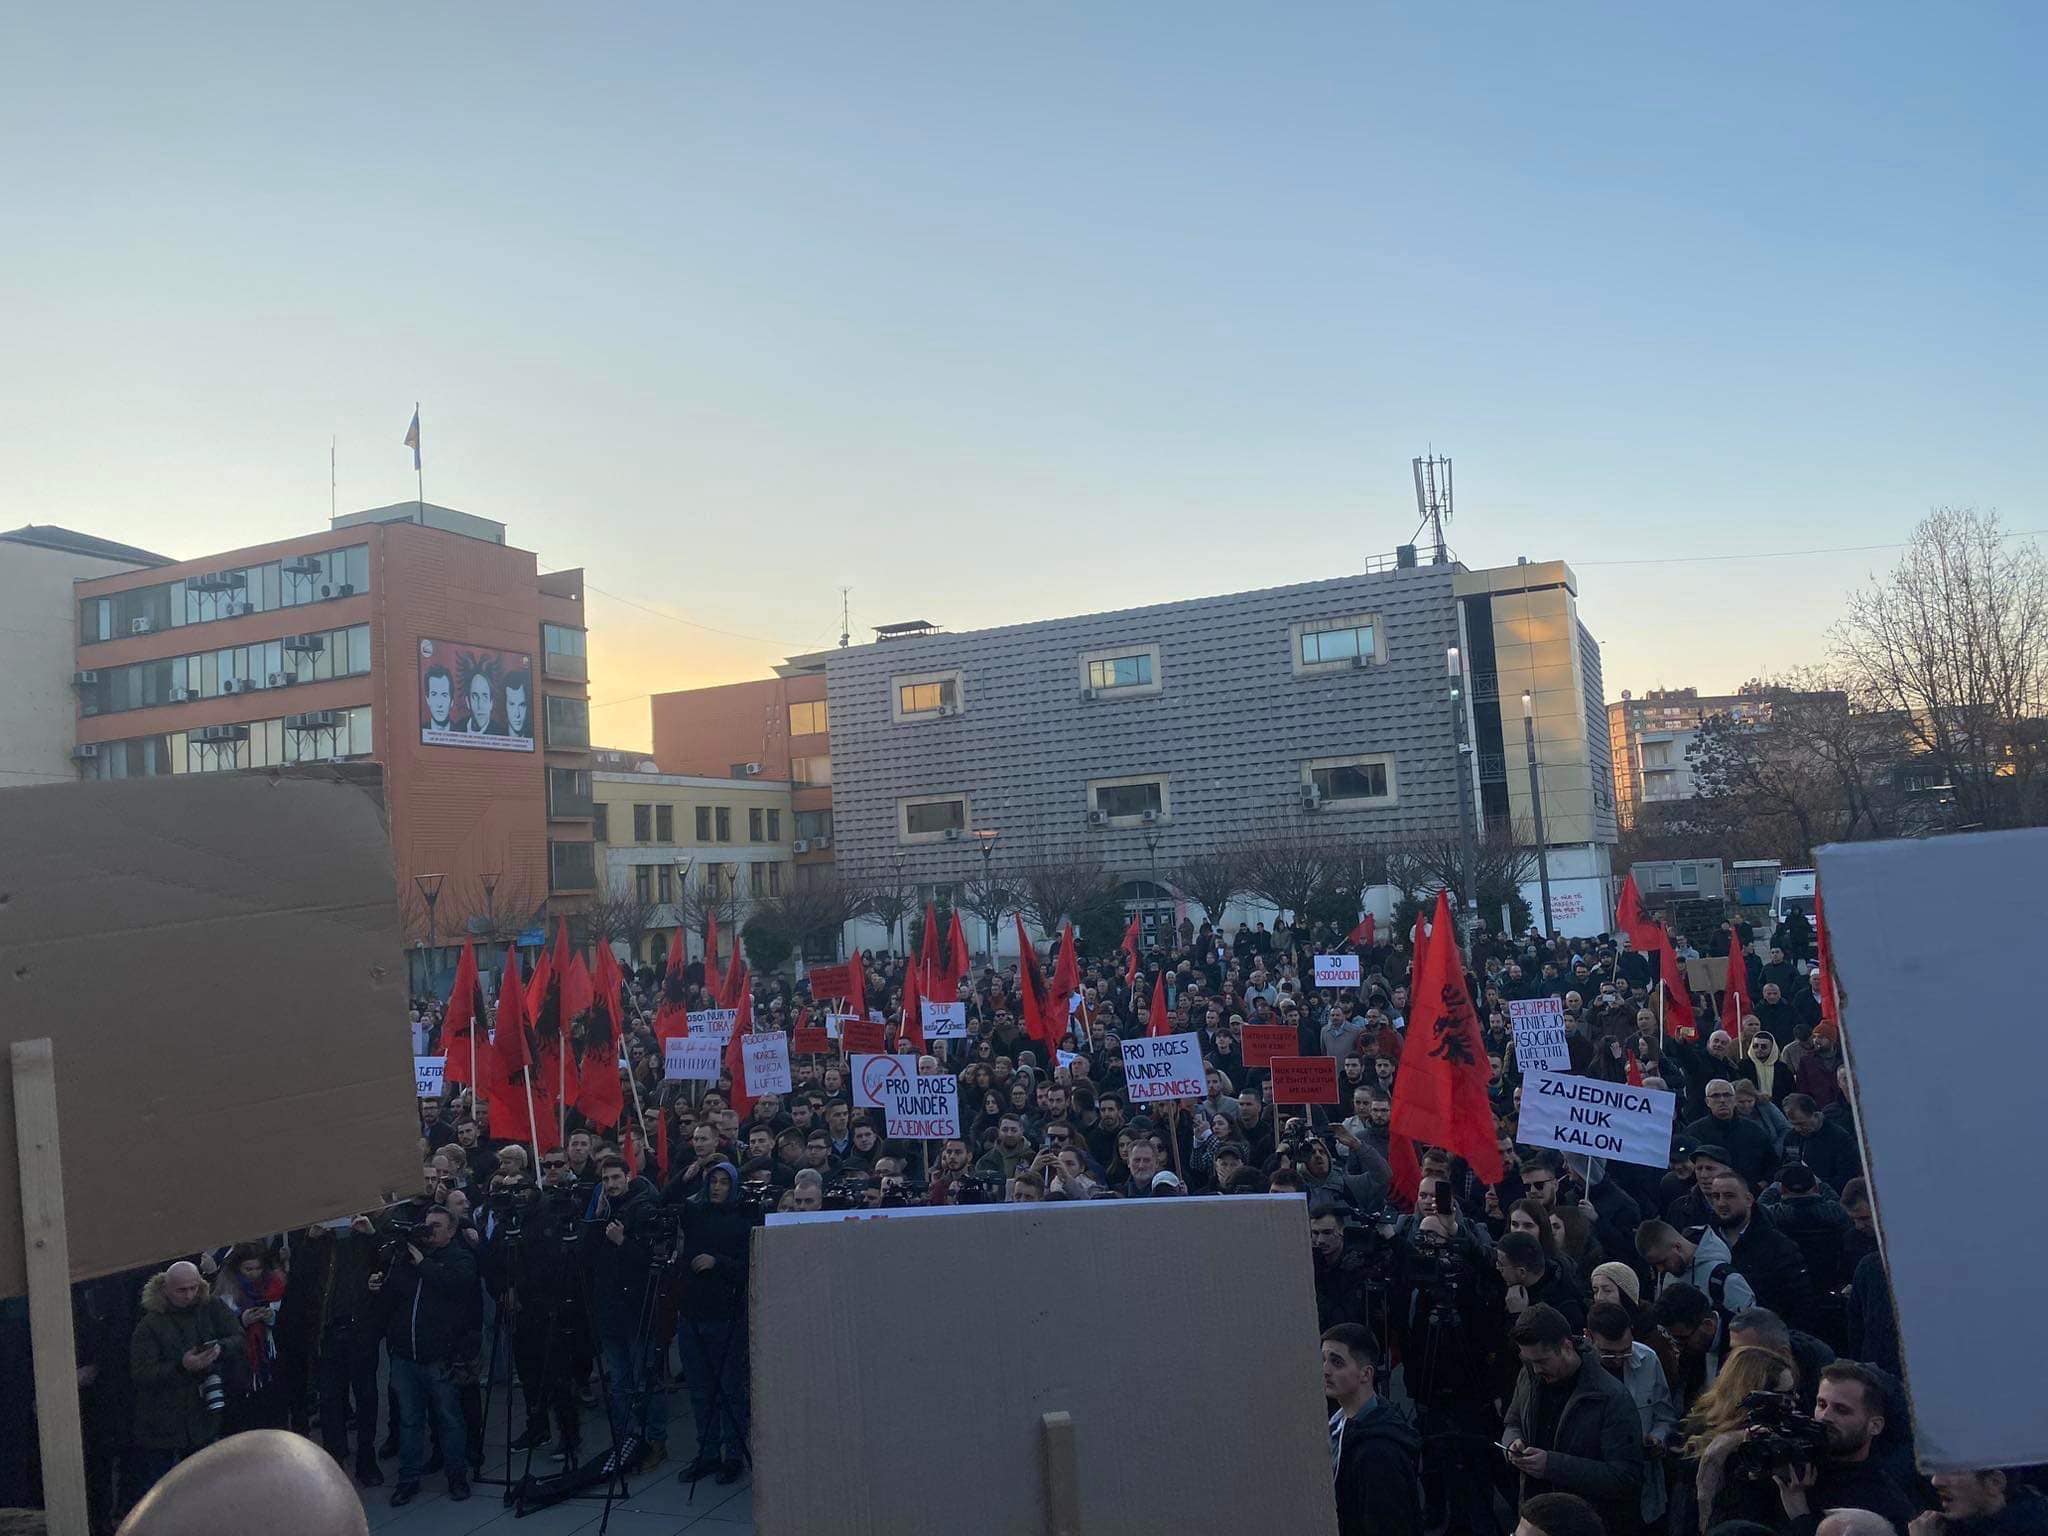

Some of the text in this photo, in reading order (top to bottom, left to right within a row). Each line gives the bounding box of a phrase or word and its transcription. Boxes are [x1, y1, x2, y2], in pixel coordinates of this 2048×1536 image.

[1329, 957, 1342, 968] JO
[707, 1010, 724, 1021] NUK
[1123, 1043, 1145, 1060] PRO
[1126, 1062, 1173, 1080] KUNDER
[886, 1078, 910, 1095] PRO
[916, 1077, 956, 1095] PAQES
[1539, 1079, 1652, 1114] ZAJEDNICA
[896, 1096, 949, 1116] KUNDER
[1570, 1107, 1612, 1128] NUK
[1554, 1125, 1623, 1153] KALON
